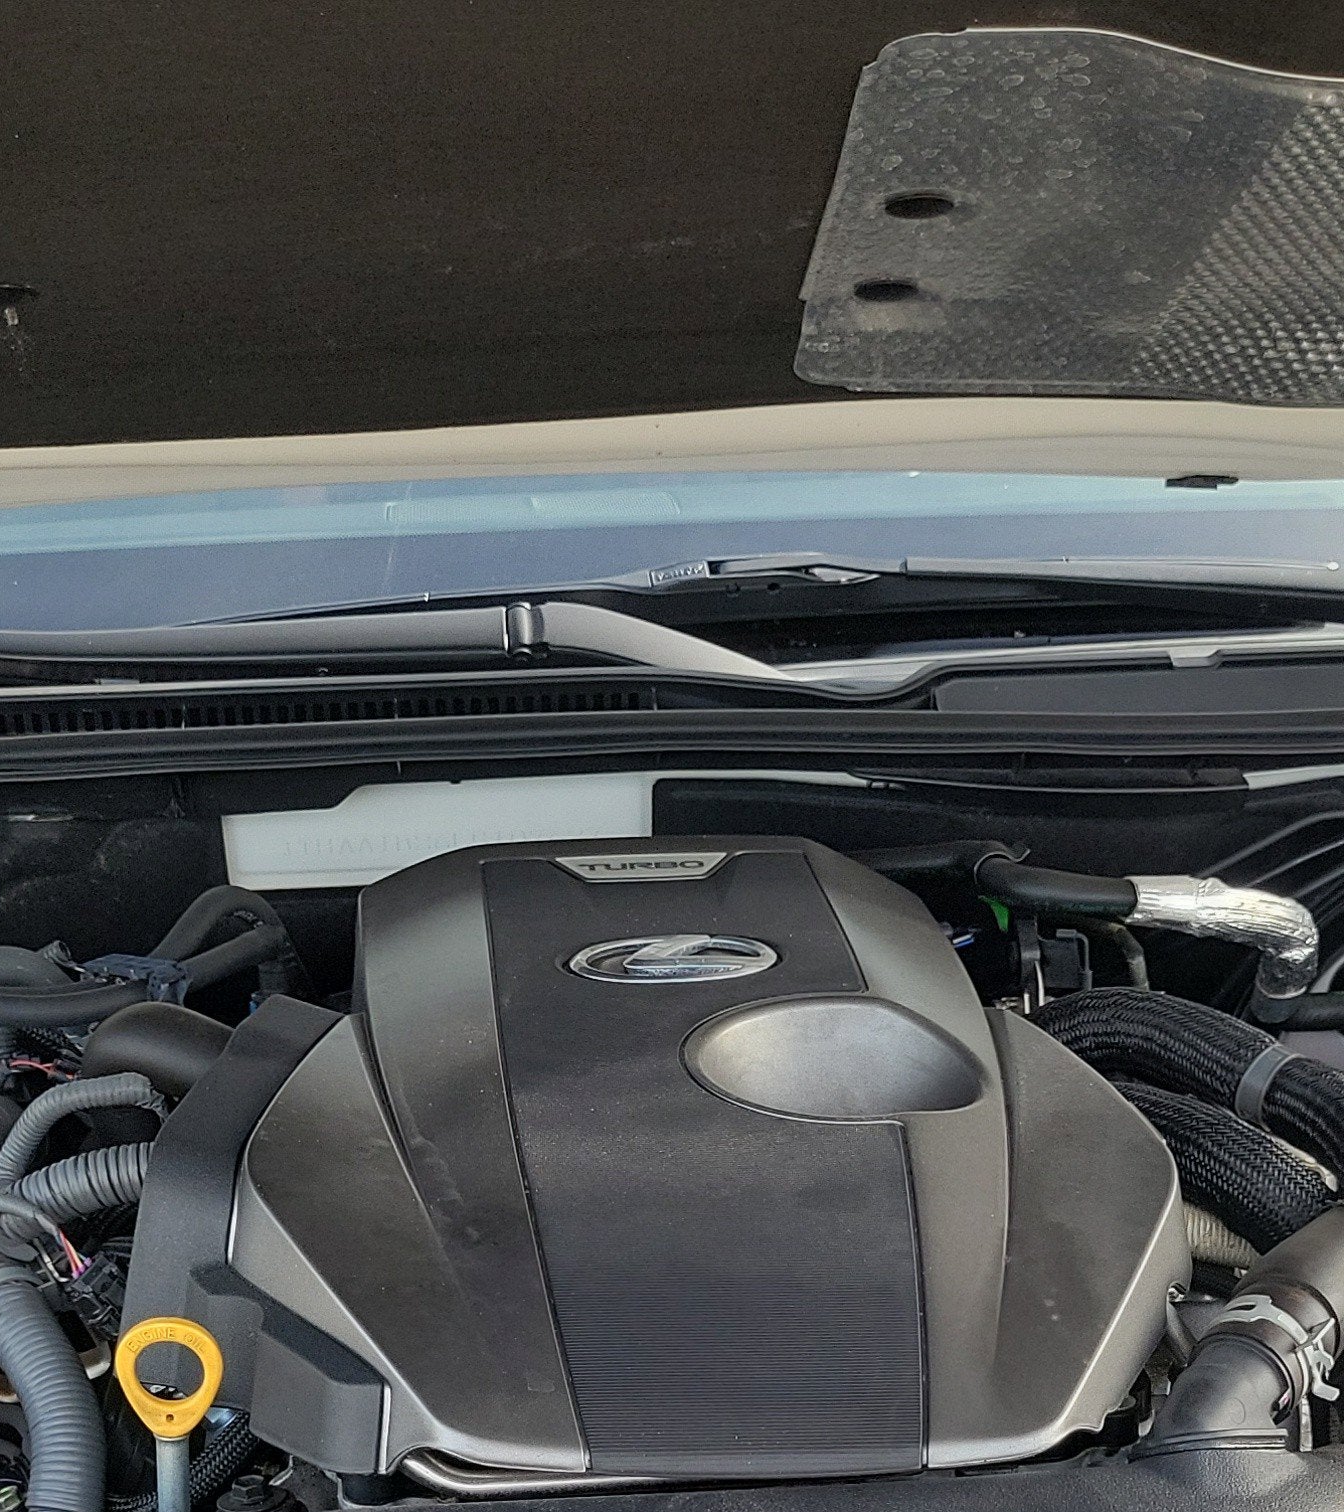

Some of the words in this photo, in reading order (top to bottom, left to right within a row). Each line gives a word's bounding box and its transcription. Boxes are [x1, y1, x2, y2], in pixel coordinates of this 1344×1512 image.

[578, 859, 706, 872] TURBO
[127, 1327, 176, 1353] ENGINE
[184, 1333, 207, 1354] OIL
